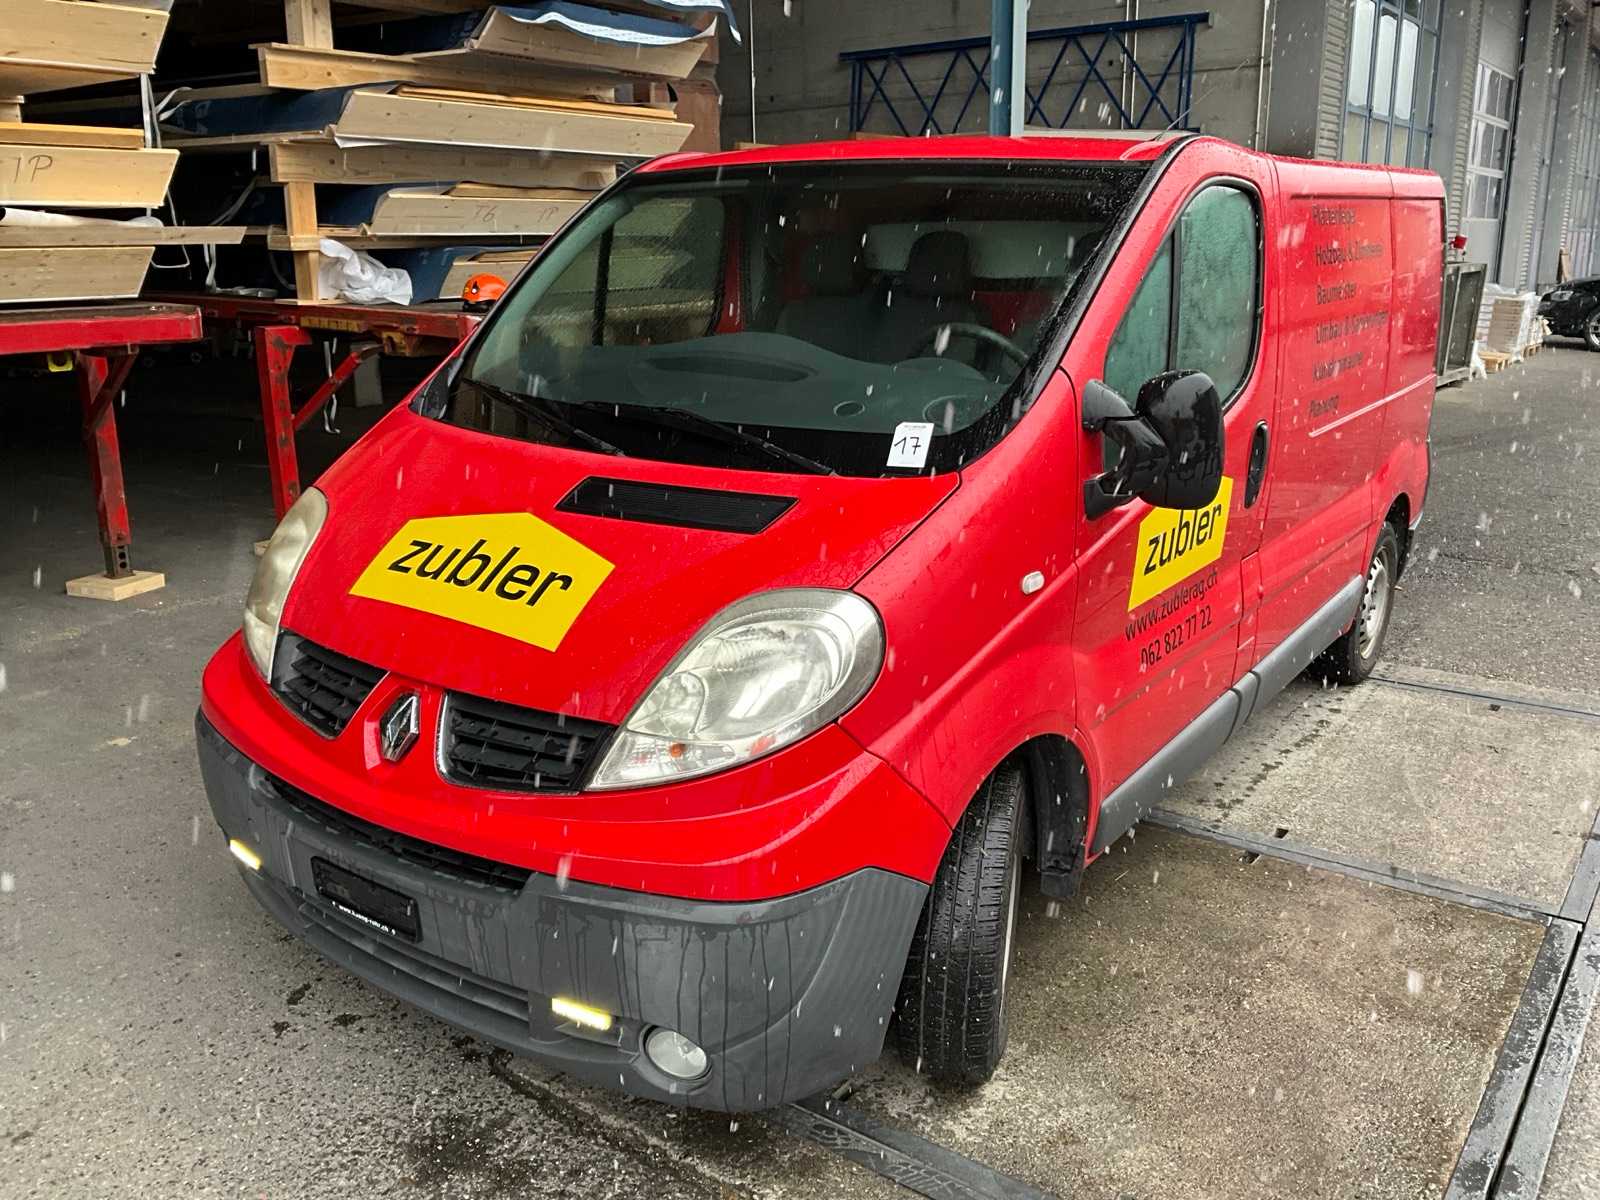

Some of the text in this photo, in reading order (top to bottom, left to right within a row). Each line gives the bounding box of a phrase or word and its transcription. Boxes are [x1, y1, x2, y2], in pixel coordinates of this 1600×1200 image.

[894, 436, 922, 455] 17
[387, 539, 573, 607] zubler
[1143, 503, 1222, 576] zubler
[1125, 570, 1219, 642] www.zublerag.ch
[1140, 605, 1213, 668] 062 822 77 22
